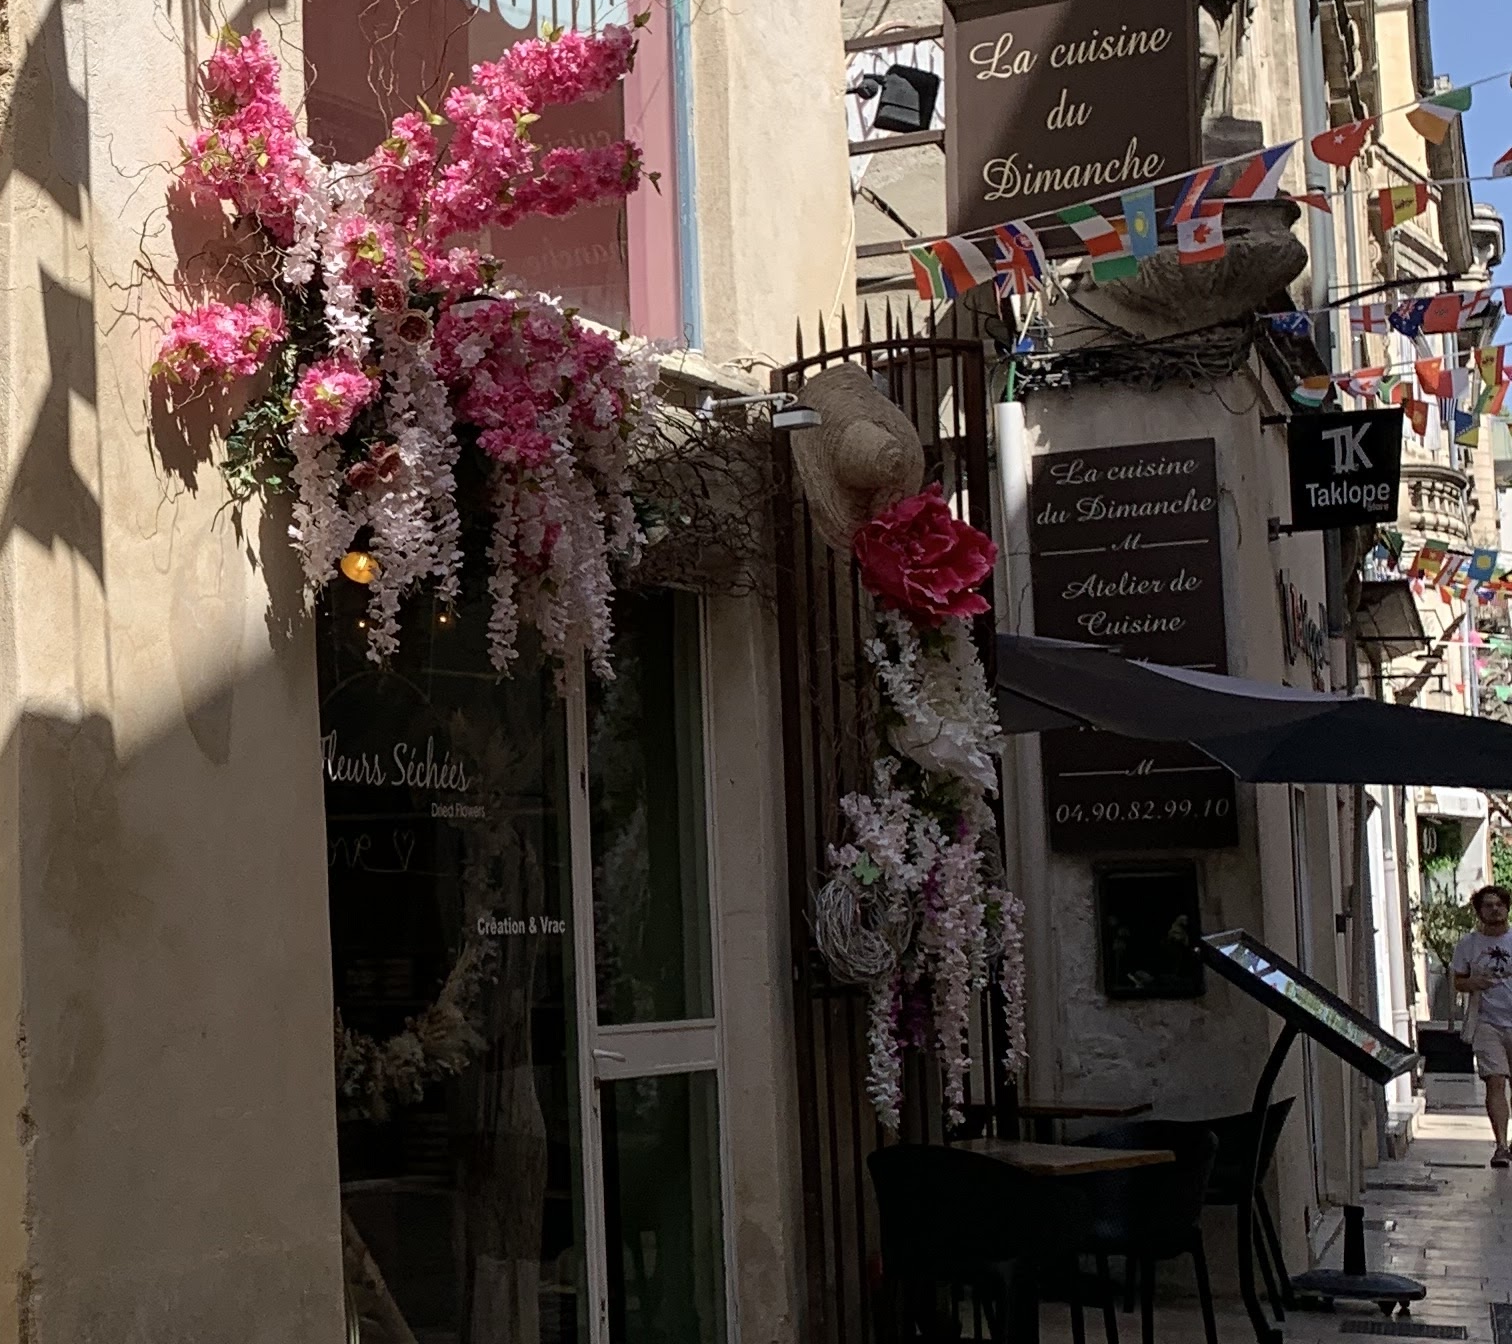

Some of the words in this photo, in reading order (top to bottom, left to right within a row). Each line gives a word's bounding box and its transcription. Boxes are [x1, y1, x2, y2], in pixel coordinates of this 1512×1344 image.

[969, 32, 1038, 80] La
[1049, 24, 1172, 68] cuisine
[1046, 88, 1092, 131] du
[982, 136, 1165, 201] Dimanche
[1050, 458, 1105, 485] La
[1107, 457, 1200, 481] cuisine
[1037, 503, 1071, 525] du
[1076, 488, 1217, 522] Dimanche
[1305, 481, 1390, 510] Taklope
[1061, 571, 1166, 600] Atelier
[1170, 568, 1203, 592] de
[1077, 611, 1186, 636] Cuisine
[390, 735, 471, 793] Séchées
[1055, 797, 1231, 825] 04.90.82.99.10
[476, 916, 526, 936] Création
[528, 916, 538, 934] &
[540, 917, 566, 935] Vrac
